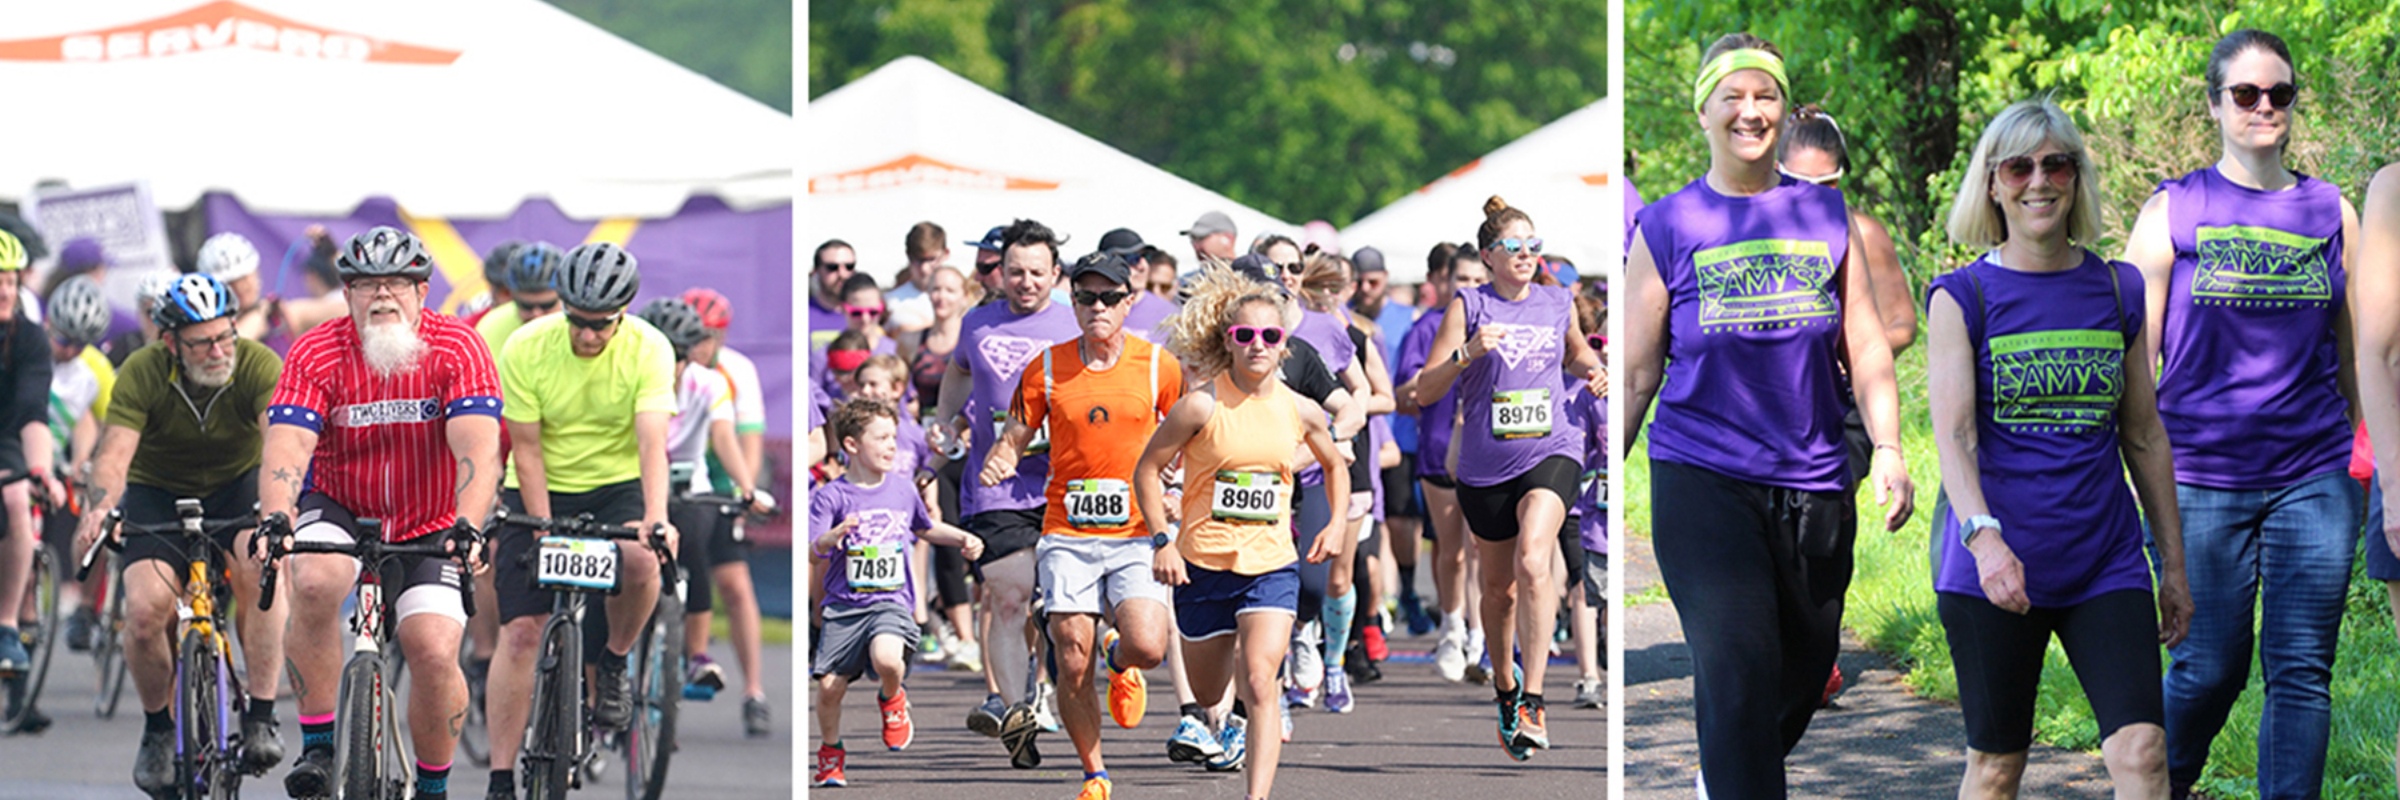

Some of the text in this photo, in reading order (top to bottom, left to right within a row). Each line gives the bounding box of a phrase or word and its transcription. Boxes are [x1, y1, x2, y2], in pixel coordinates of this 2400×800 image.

[61, 18, 371, 61] SERVPRO
[1726, 266, 1813, 296] AMY'S
[2023, 361, 2114, 395] AMY'S
[1498, 404, 1547, 425] 8976
[1070, 493, 1123, 516] 7488
[1221, 487, 1275, 510] 8960
[543, 552, 612, 580] 10882
[852, 557, 897, 580] 7487
